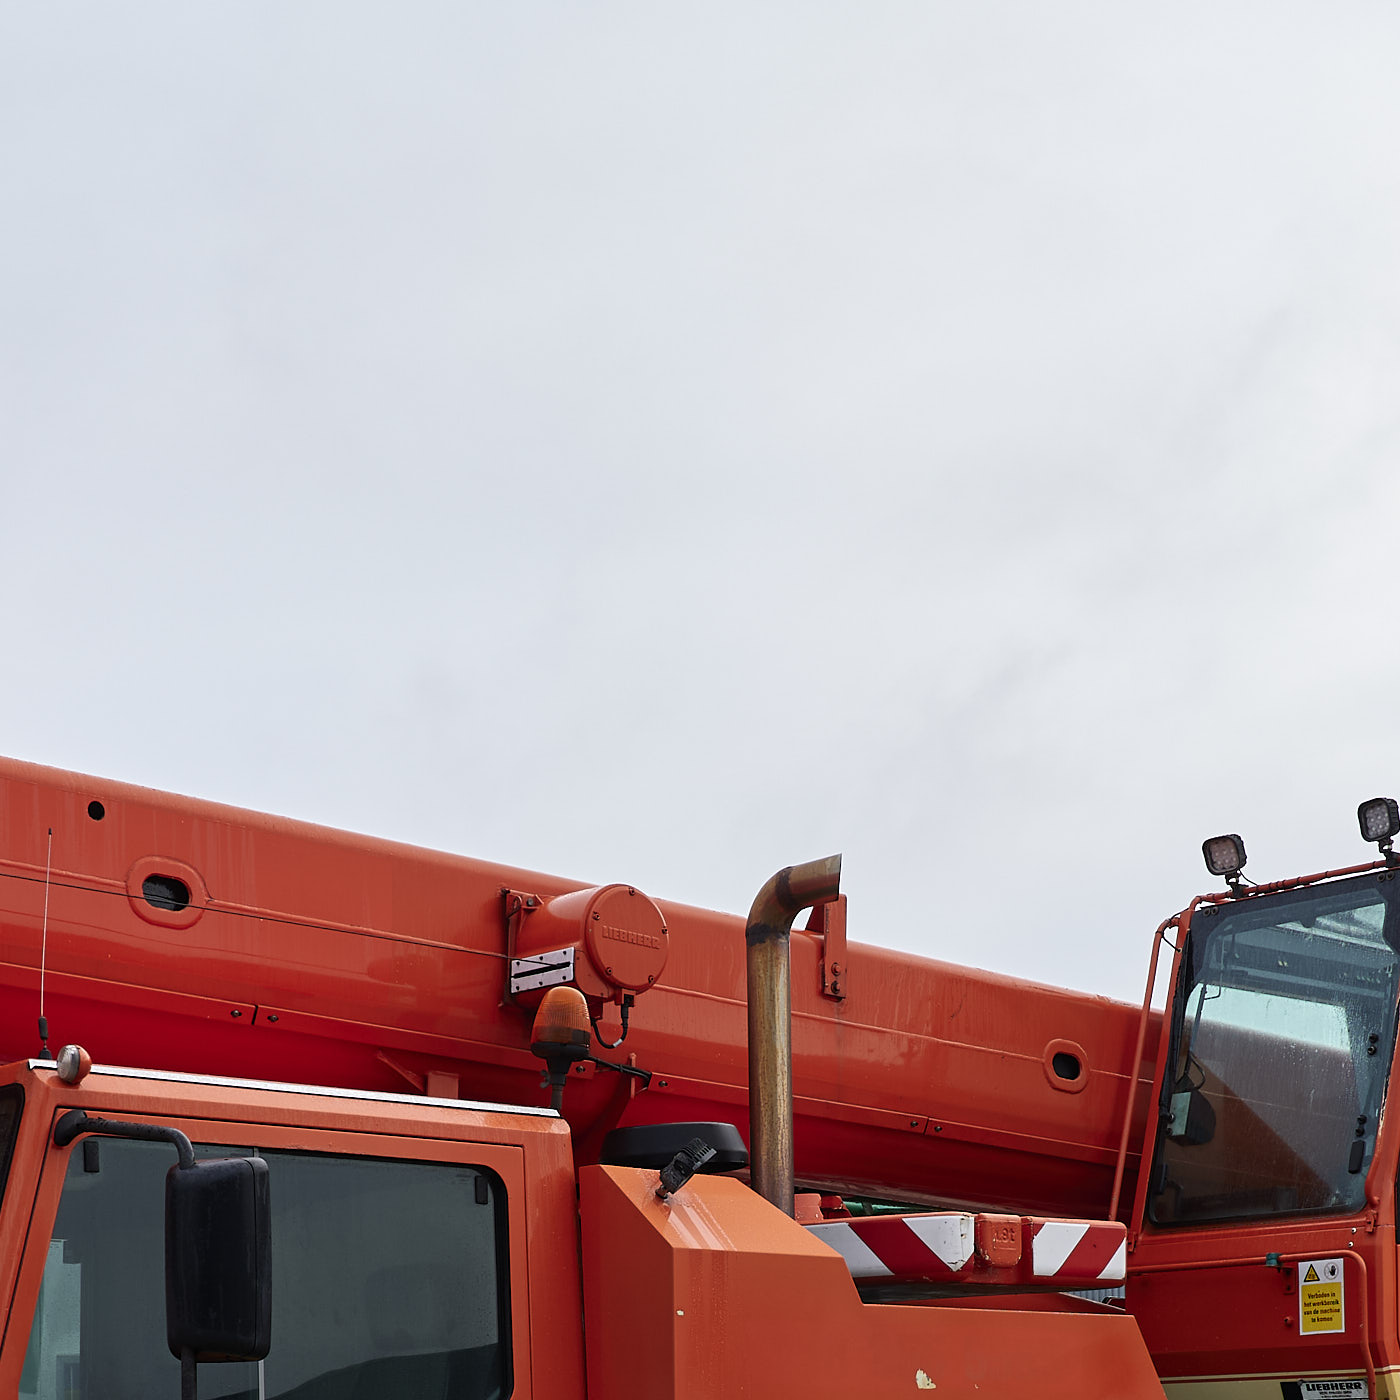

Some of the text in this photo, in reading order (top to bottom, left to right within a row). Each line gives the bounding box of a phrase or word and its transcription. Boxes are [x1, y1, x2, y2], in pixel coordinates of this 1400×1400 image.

[602, 925, 660, 950] LIEBHERR
[1312, 1299, 1339, 1307] werkbereik
[1306, 1382, 1362, 1391] LIEBHERR
